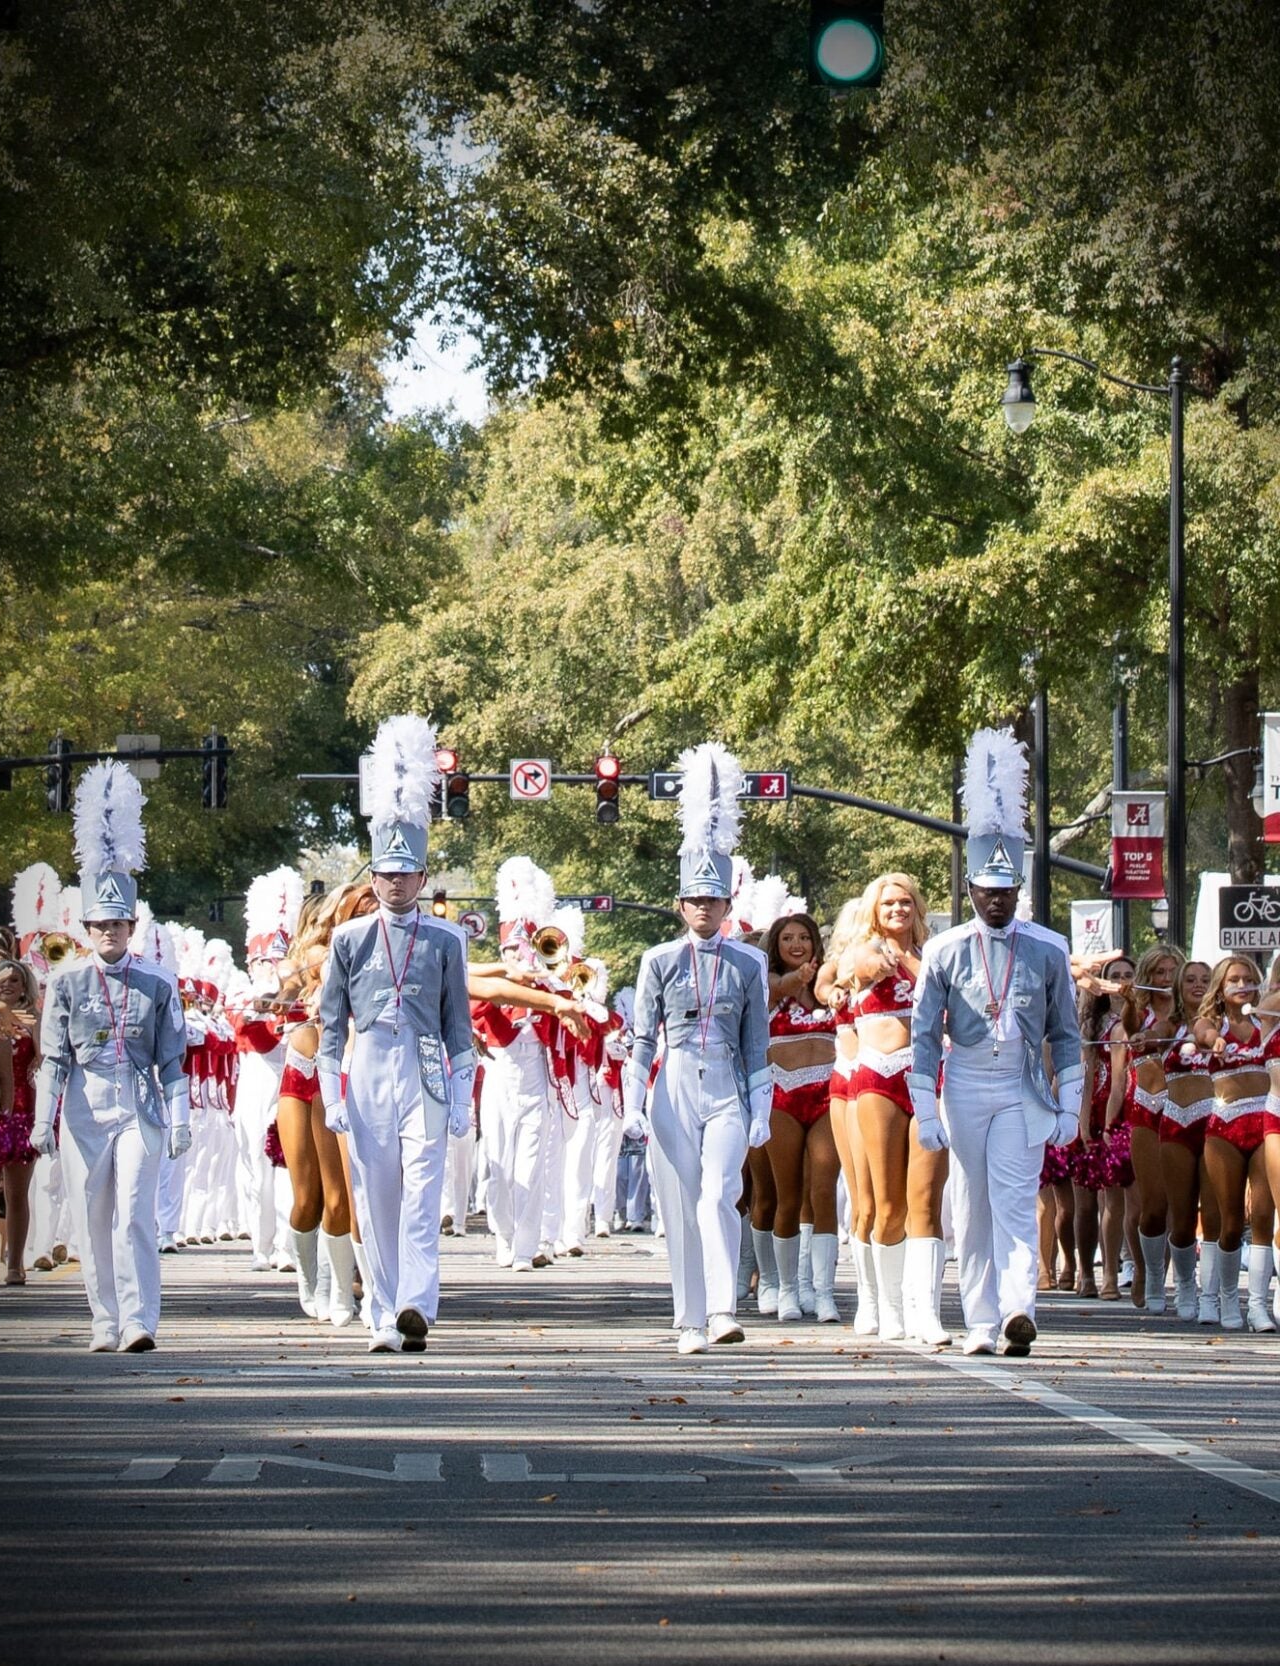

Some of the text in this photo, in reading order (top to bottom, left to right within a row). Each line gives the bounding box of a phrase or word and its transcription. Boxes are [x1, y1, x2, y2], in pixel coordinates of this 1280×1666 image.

[1123, 851, 1153, 862] TOP 5
[1223, 931, 1280, 946] BIKE LA
